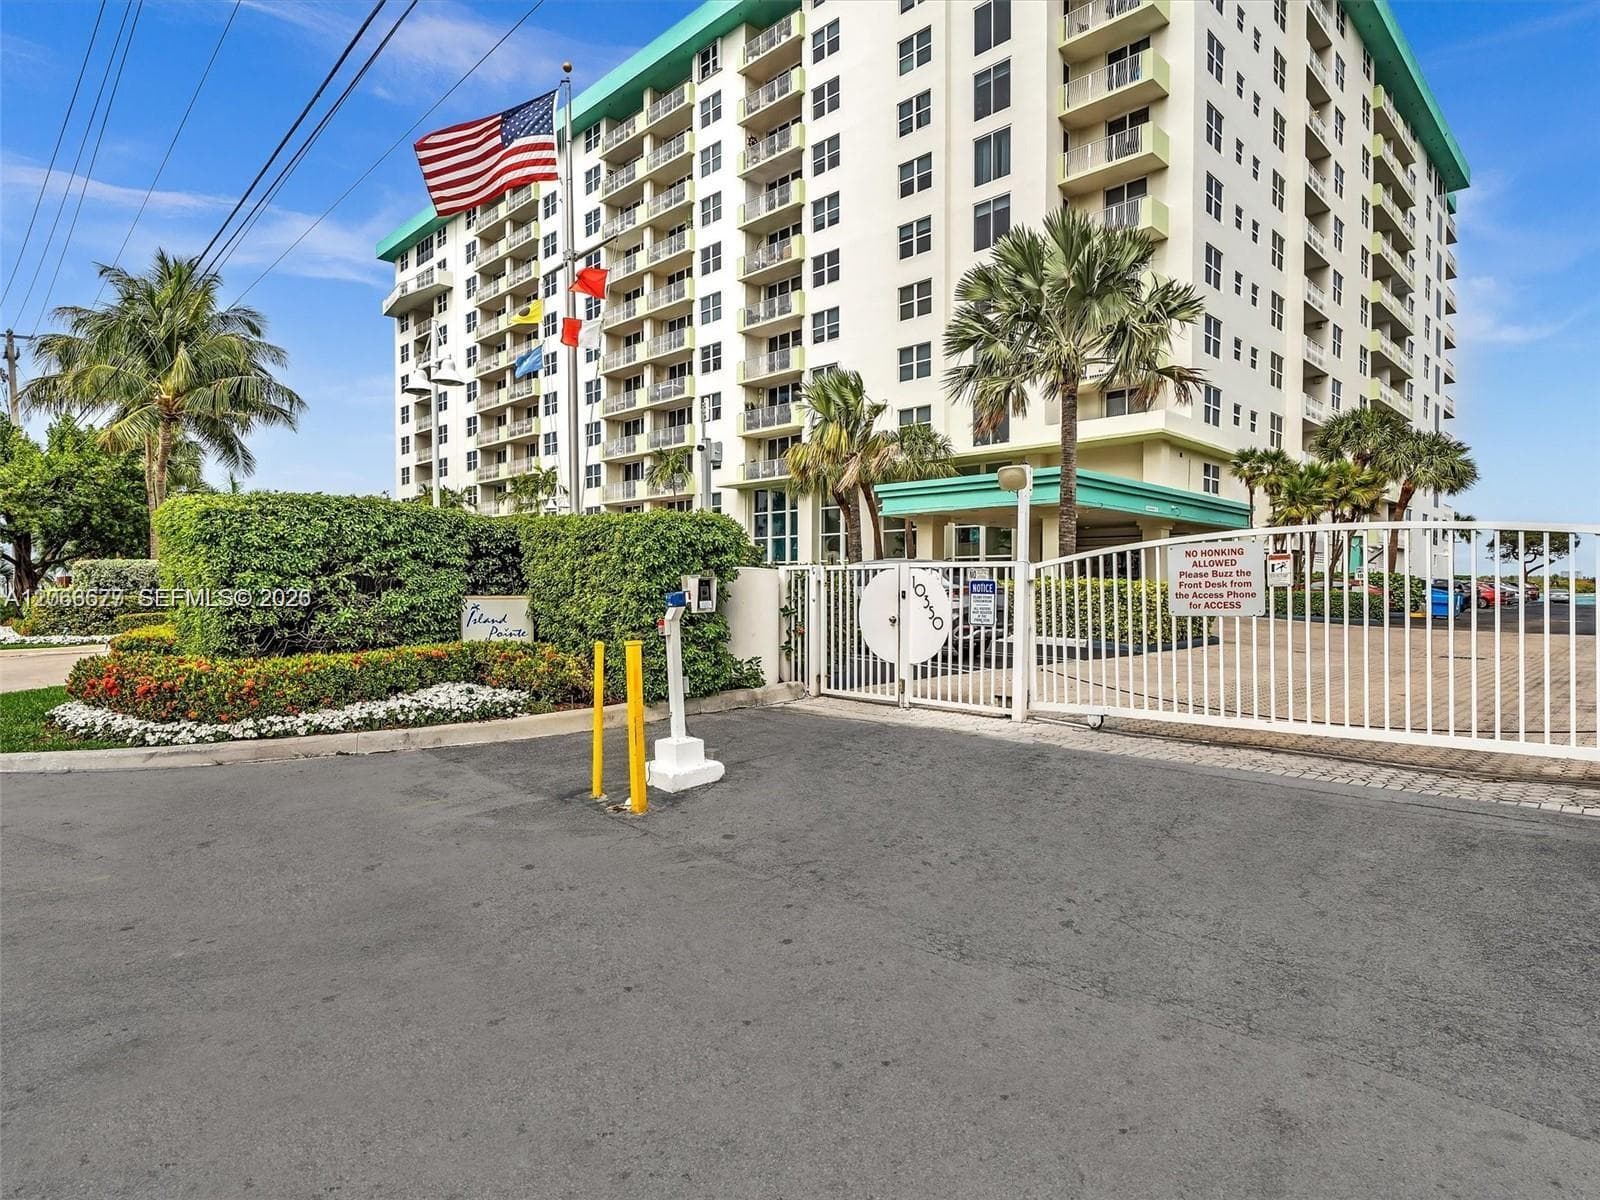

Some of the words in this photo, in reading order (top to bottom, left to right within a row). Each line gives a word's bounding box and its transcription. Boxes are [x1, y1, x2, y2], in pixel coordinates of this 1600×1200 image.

[1185, 550, 1198, 558] NO
[1200, 548, 1244, 557] HONKING
[1192, 559, 1237, 568] ALLOWED
[1179, 570, 1209, 579] Please
[1211, 570, 1233, 578] Buzz
[1236, 569, 1252, 577] the
[972, 583, 994, 592] NOTICE
[1178, 581, 1202, 589] Front
[1204, 580, 1228, 588] Desk
[1230, 580, 1252, 588] from
[1175, 591, 1190, 599] the
[1191, 591, 1224, 599] Access
[1226, 590, 1257, 599] Phone
[912, 575, 944, 630] 10350
[1189, 601, 1201, 609] for
[1203, 601, 1242, 609] ACCESS
[489, 626, 528, 641] Pointe
